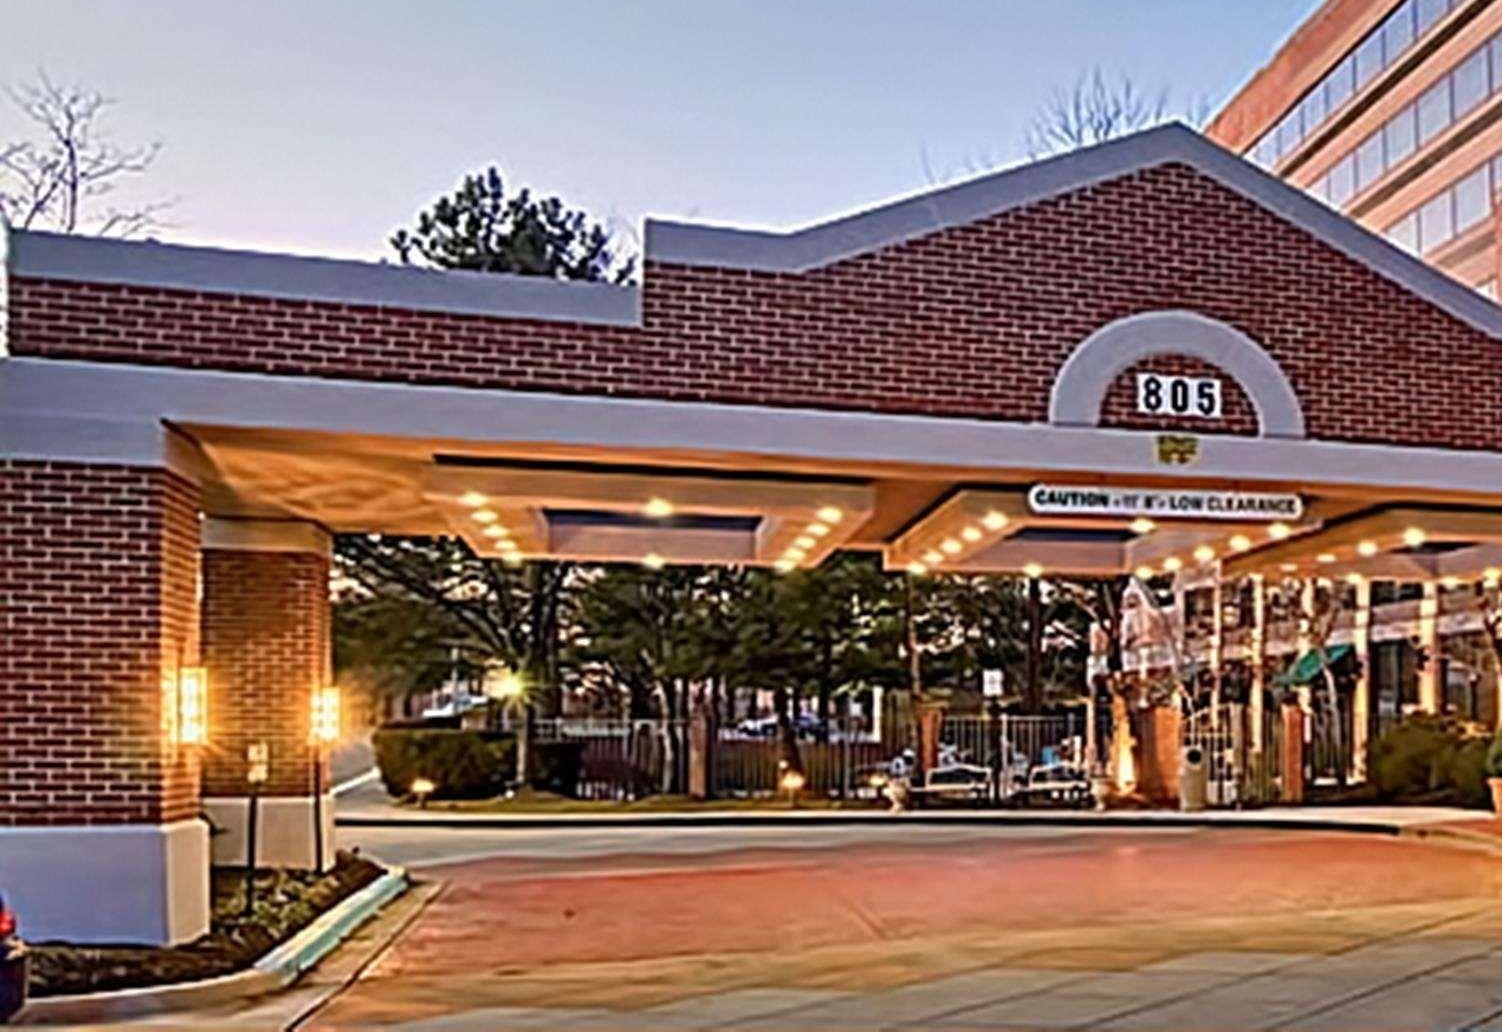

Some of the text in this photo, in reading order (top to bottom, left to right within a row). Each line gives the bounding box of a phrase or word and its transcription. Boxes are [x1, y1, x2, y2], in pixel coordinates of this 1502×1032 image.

[1143, 376, 1216, 416] 805
[1034, 488, 1109, 508] CAUTION
[1169, 495, 1203, 510] LOW
[1207, 496, 1296, 513] CLEARANCE
